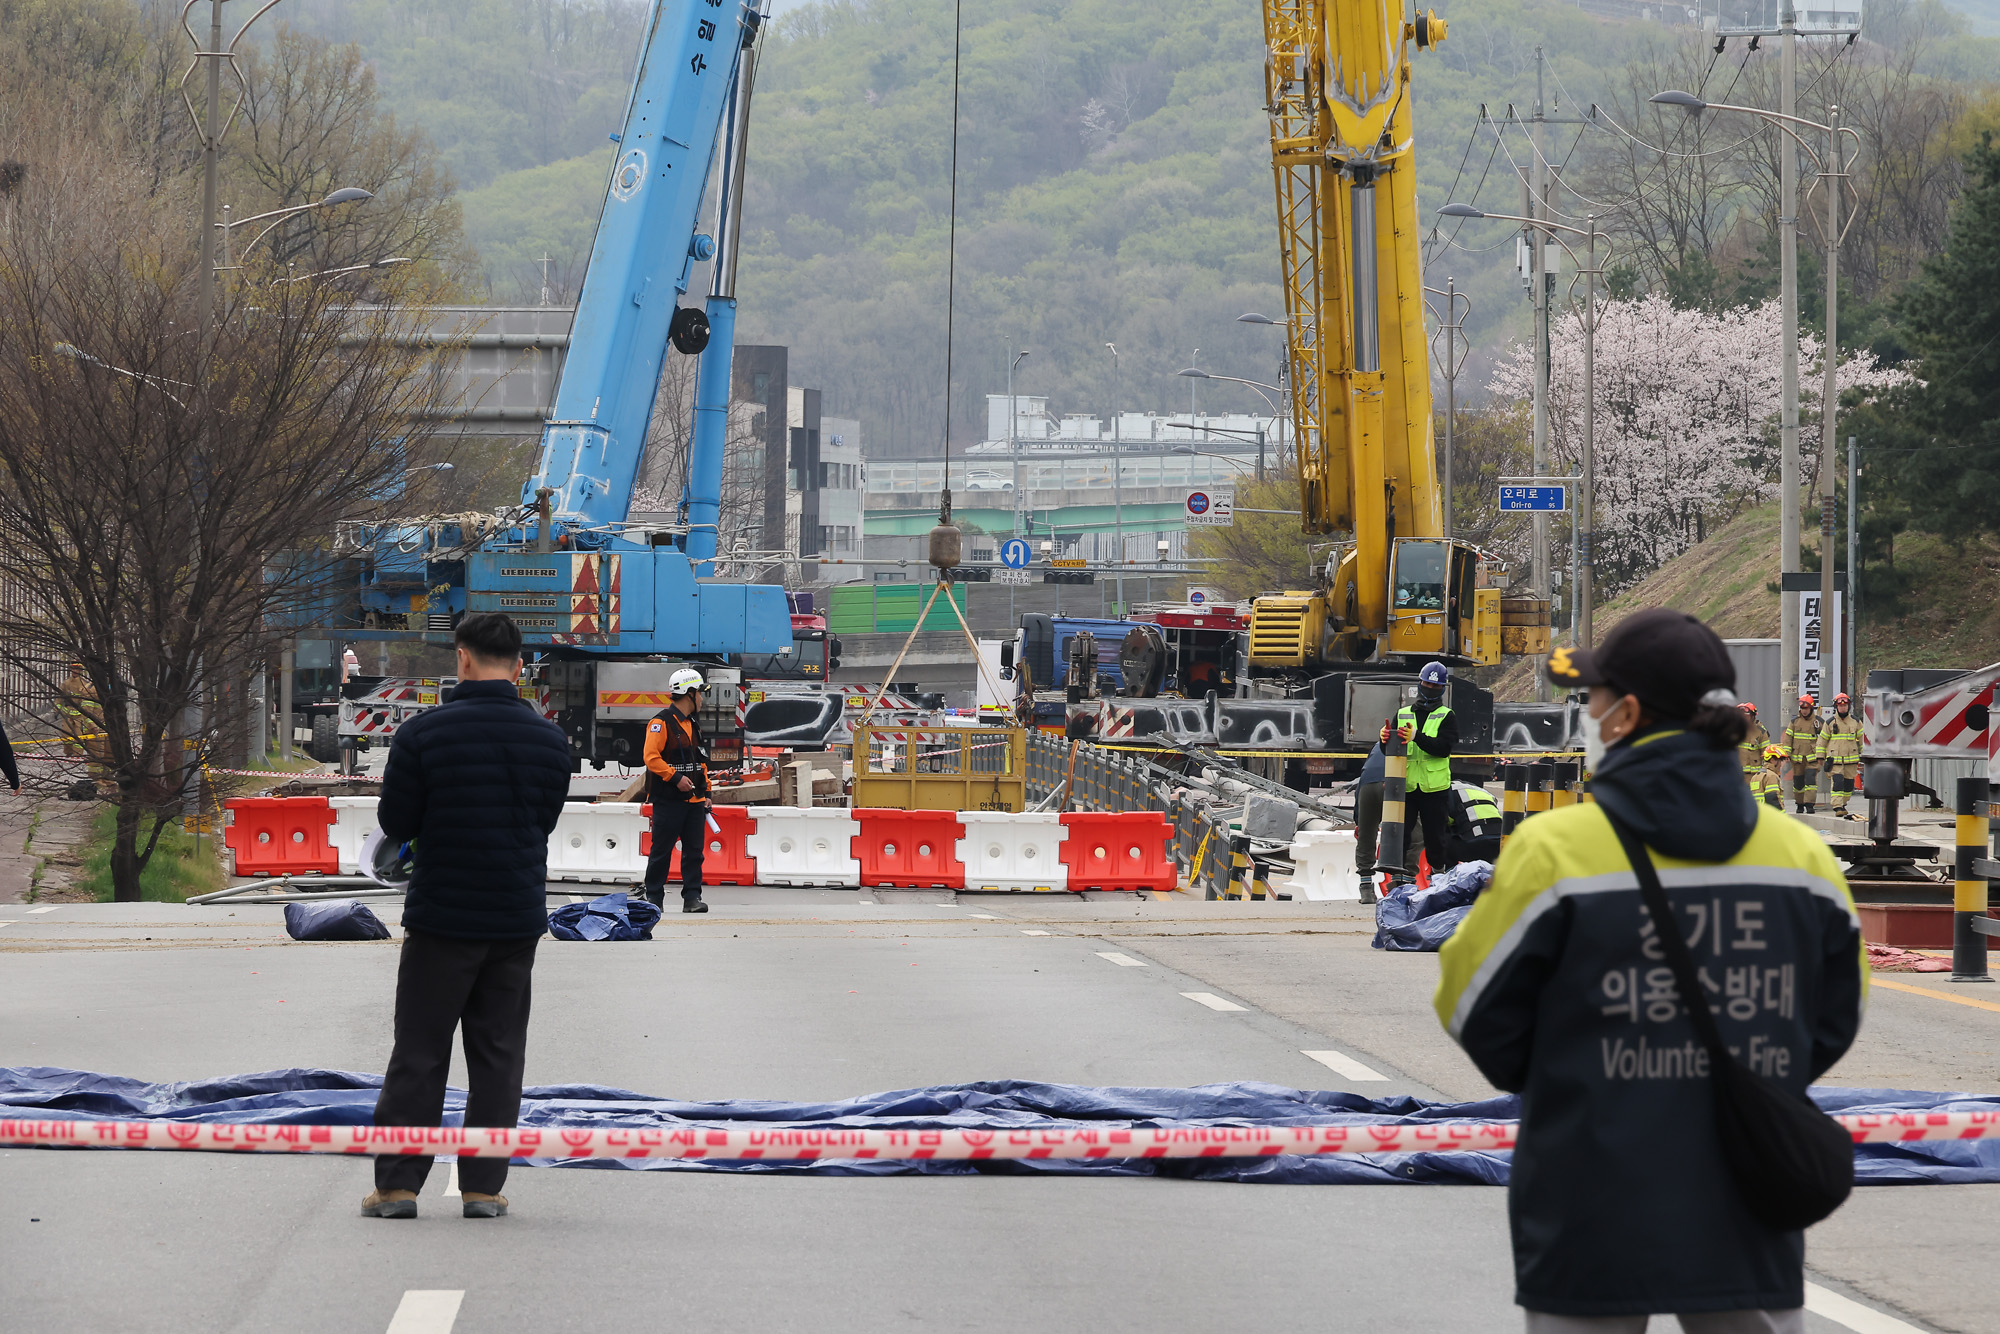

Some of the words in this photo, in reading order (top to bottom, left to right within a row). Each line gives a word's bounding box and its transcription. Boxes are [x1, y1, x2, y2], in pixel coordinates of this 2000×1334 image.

[1503, 489, 1539, 499] 오리로
[1511, 501, 1532, 509] Ori-ro
[512, 619, 556, 627] EBHERR
[802, 664, 821, 674] 구조
[1602, 1035, 1741, 1080] Volunte
[1749, 1035, 1791, 1078] Fire
